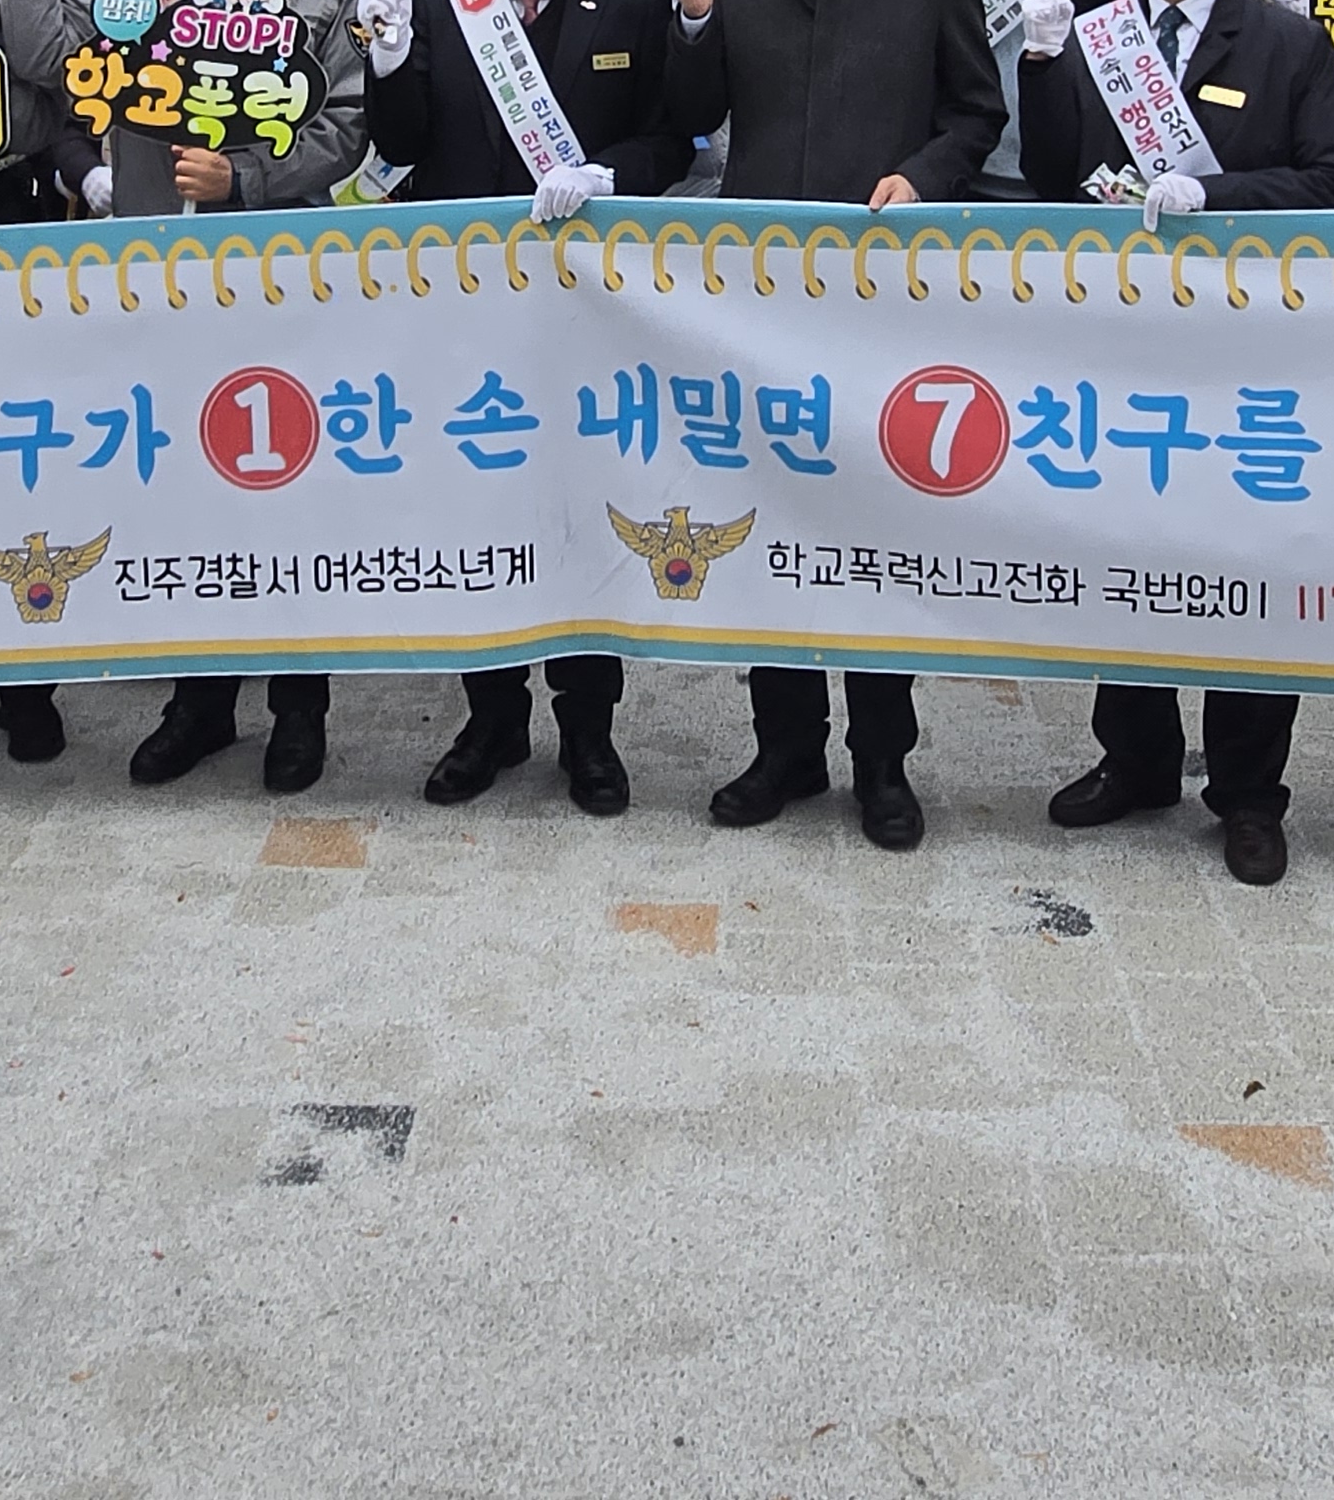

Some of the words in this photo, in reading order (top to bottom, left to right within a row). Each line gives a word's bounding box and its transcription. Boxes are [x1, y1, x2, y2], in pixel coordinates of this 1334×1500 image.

[171, 6, 297, 57] STOP!
[65, 47, 309, 157] 학교폭력
[443, 370, 540, 471] 손
[576, 362, 837, 476] 내밀면
[113, 550, 301, 602] 진주경찰서
[313, 542, 537, 595] 여성청소년계
[767, 540, 1087, 607] 학교폭력신고전화
[1101, 565, 1268, 619] 국번없이
